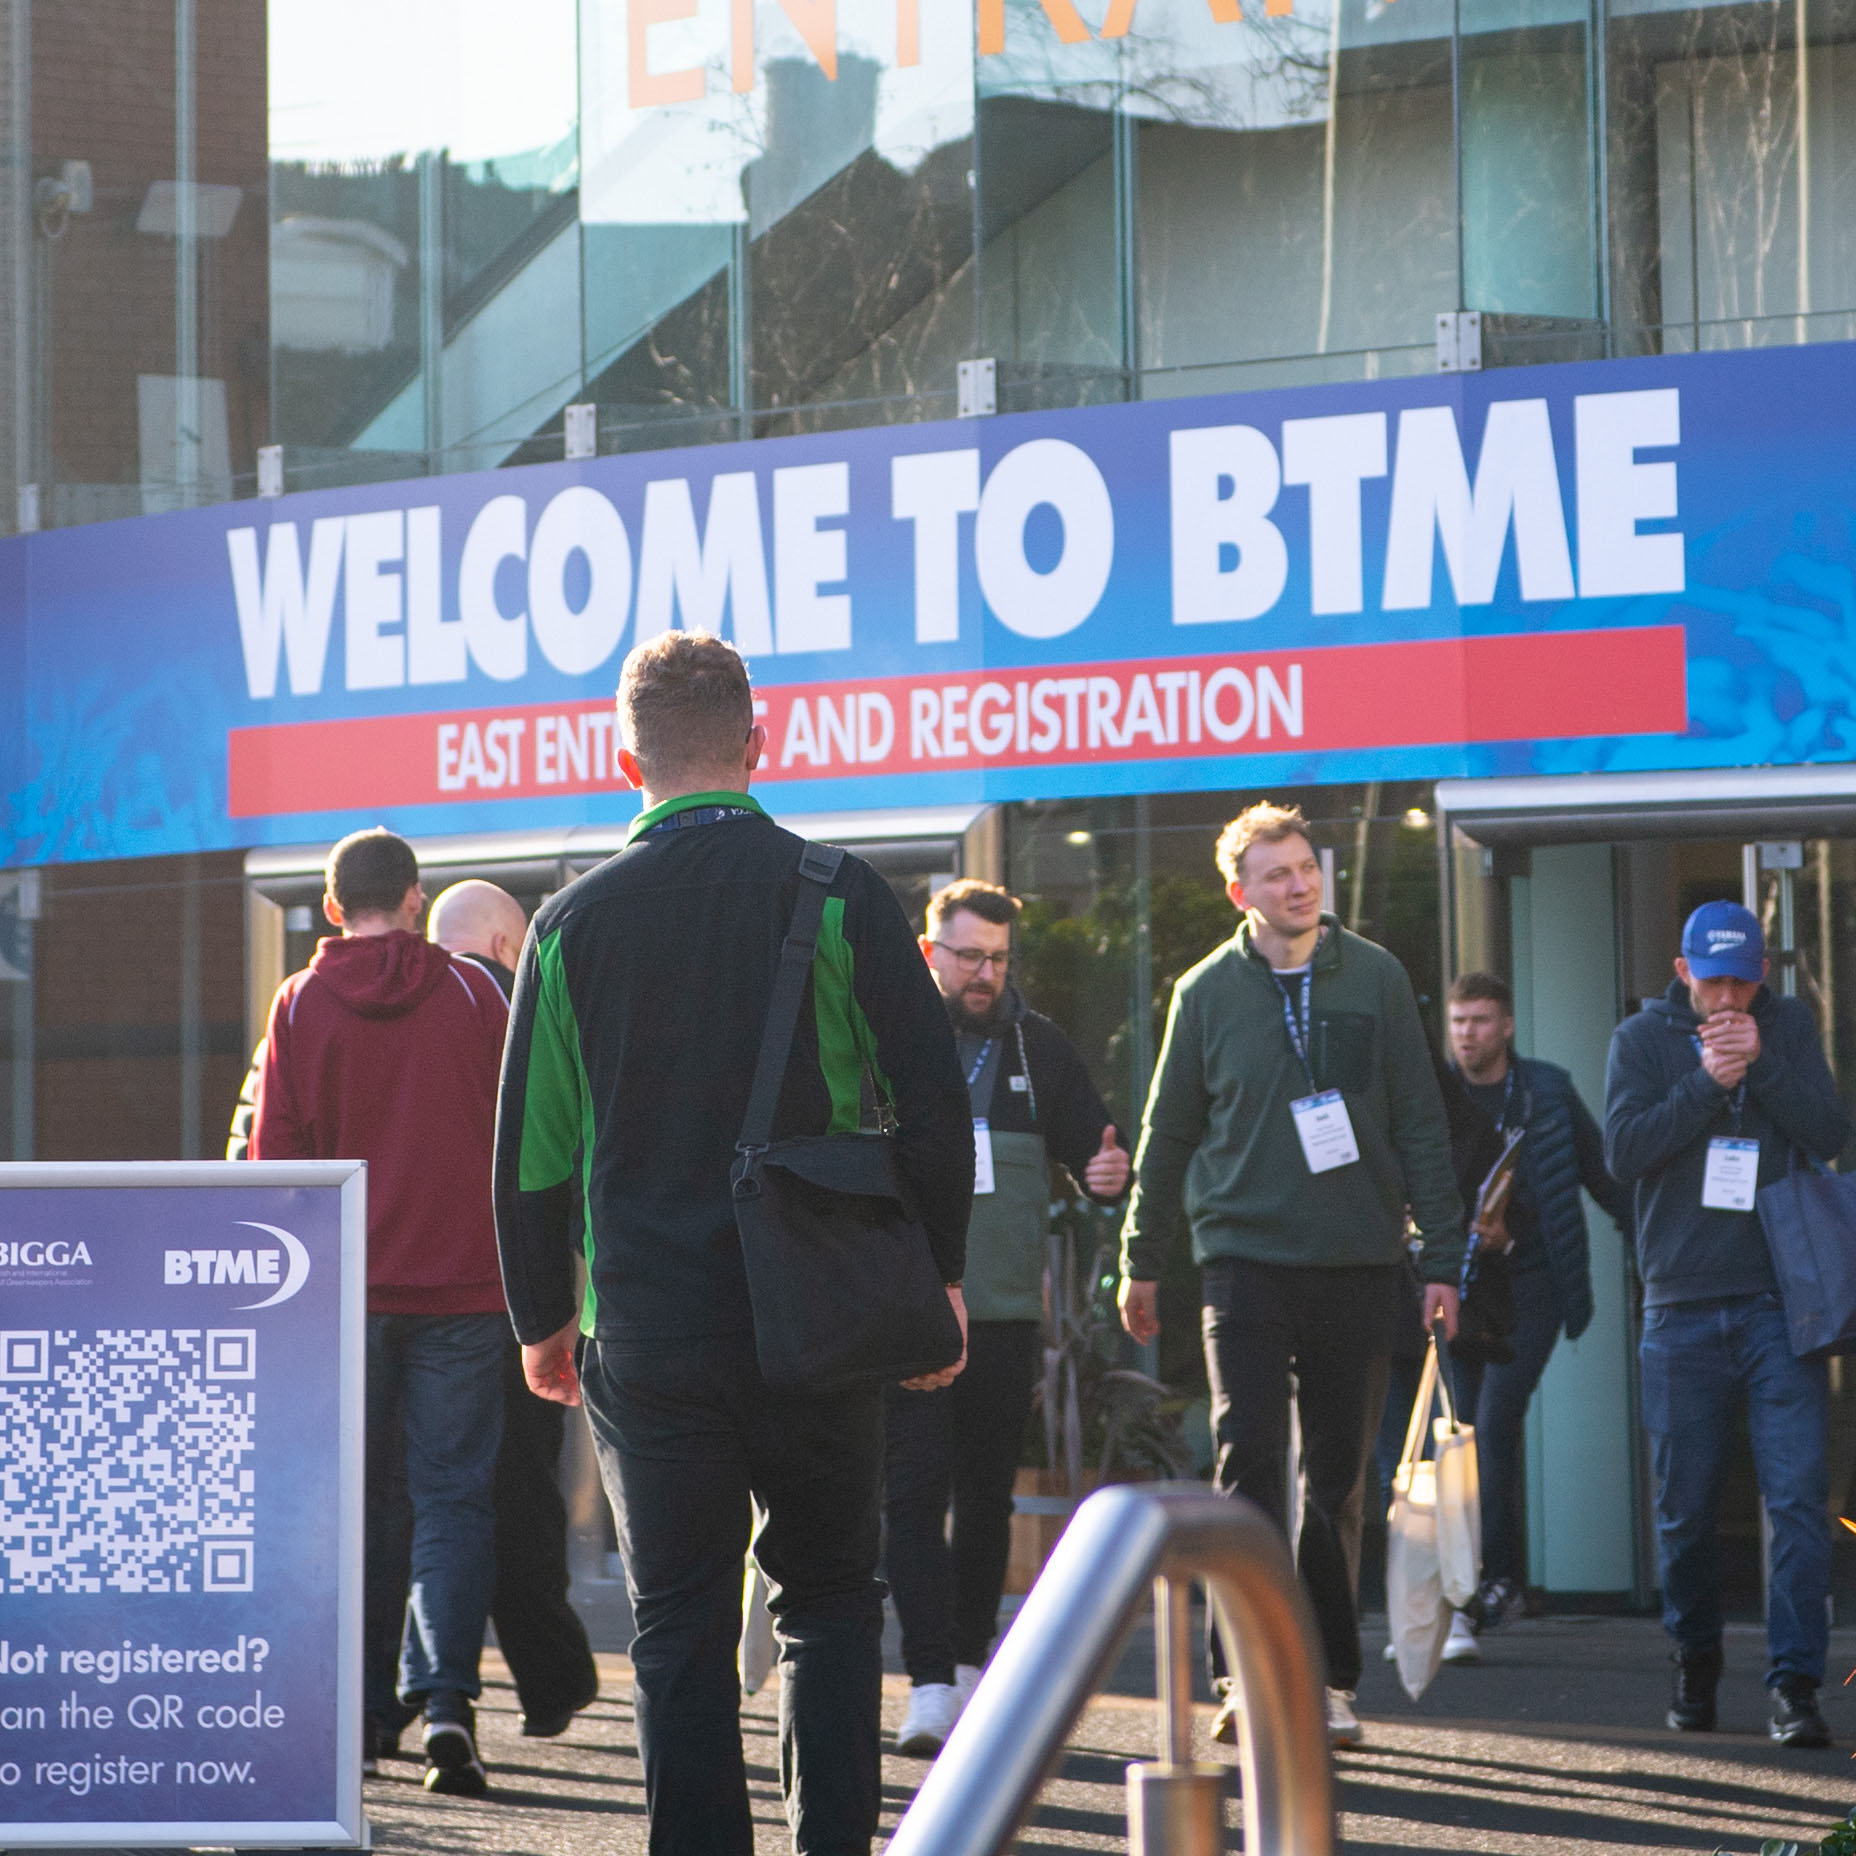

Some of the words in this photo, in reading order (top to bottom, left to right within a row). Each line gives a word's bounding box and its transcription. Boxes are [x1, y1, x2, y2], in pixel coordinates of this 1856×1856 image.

[226, 461, 852, 700] WELCOME
[892, 438, 1114, 643] TO
[1169, 387, 1686, 626] BTME
[437, 717, 526, 792] EAST
[781, 691, 895, 768] AND
[909, 664, 1304, 759] REGISTRATION
[164, 1249, 280, 1285] BTME
[60, 1635, 270, 1684] registered?
[59, 1691, 114, 1729] the
[127, 1694, 184, 1730] QR
[196, 1690, 286, 1729] code
[35, 1754, 164, 1796] register
[175, 1760, 256, 1785] now.
